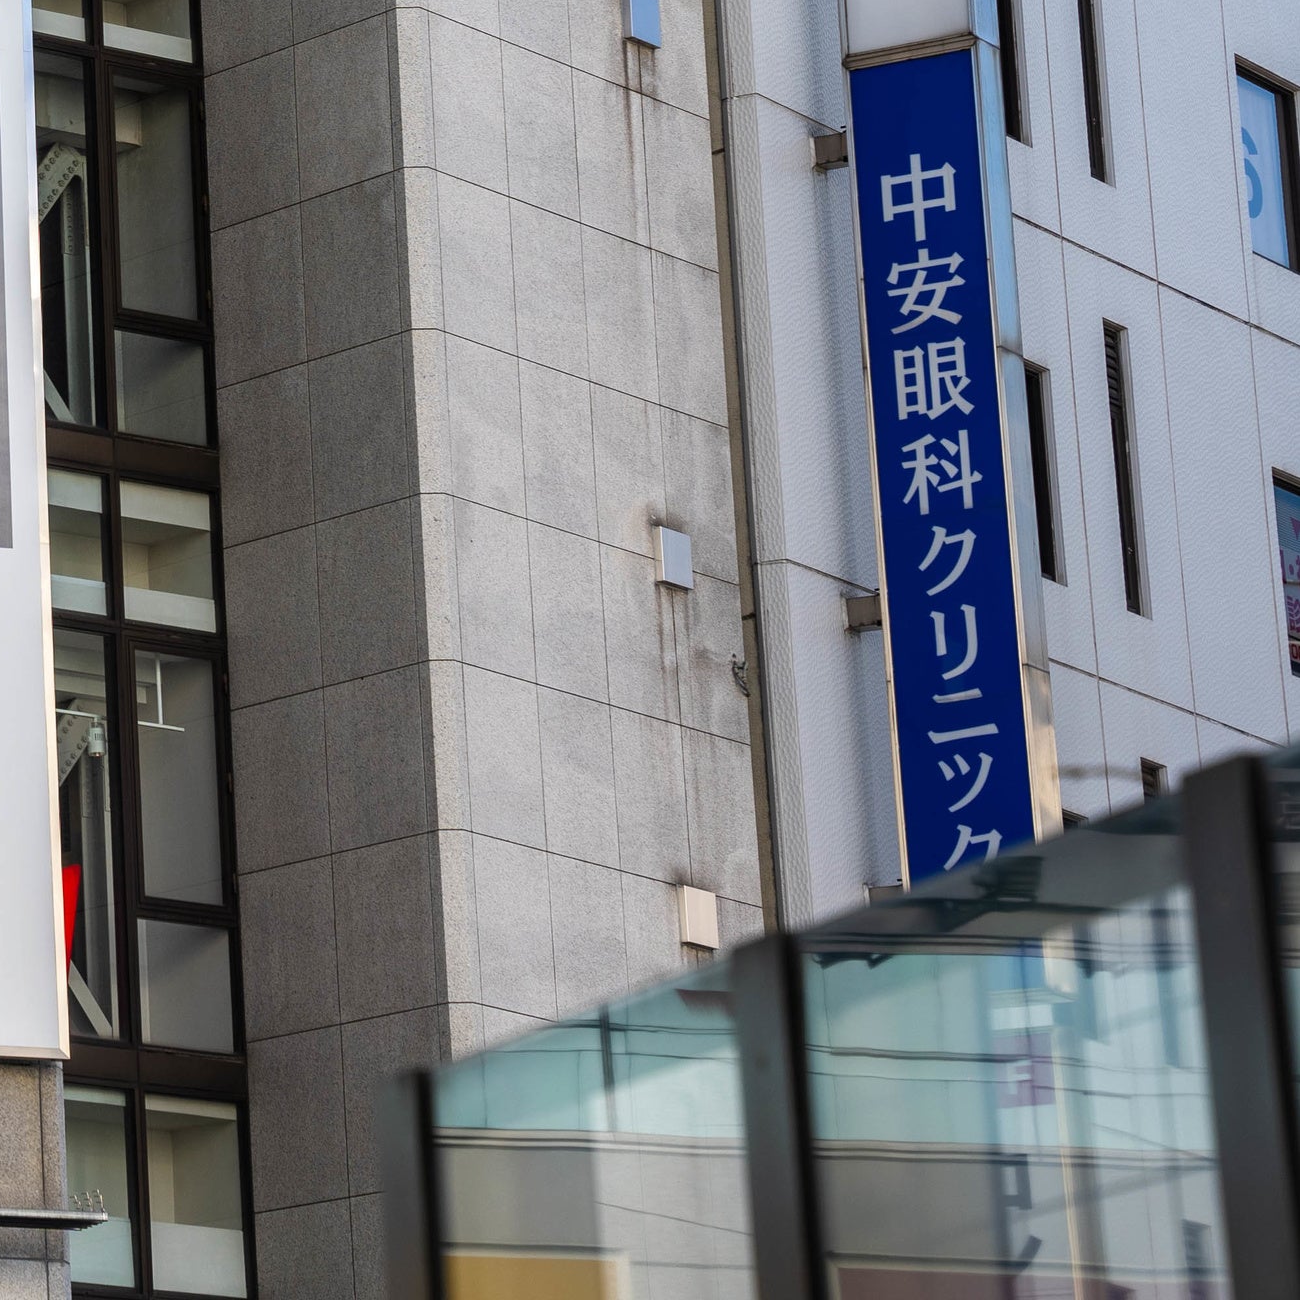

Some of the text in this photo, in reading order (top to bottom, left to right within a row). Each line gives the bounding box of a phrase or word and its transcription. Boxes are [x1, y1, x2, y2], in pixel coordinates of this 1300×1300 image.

[880, 153, 1003, 871] 中安眼科クリニック
